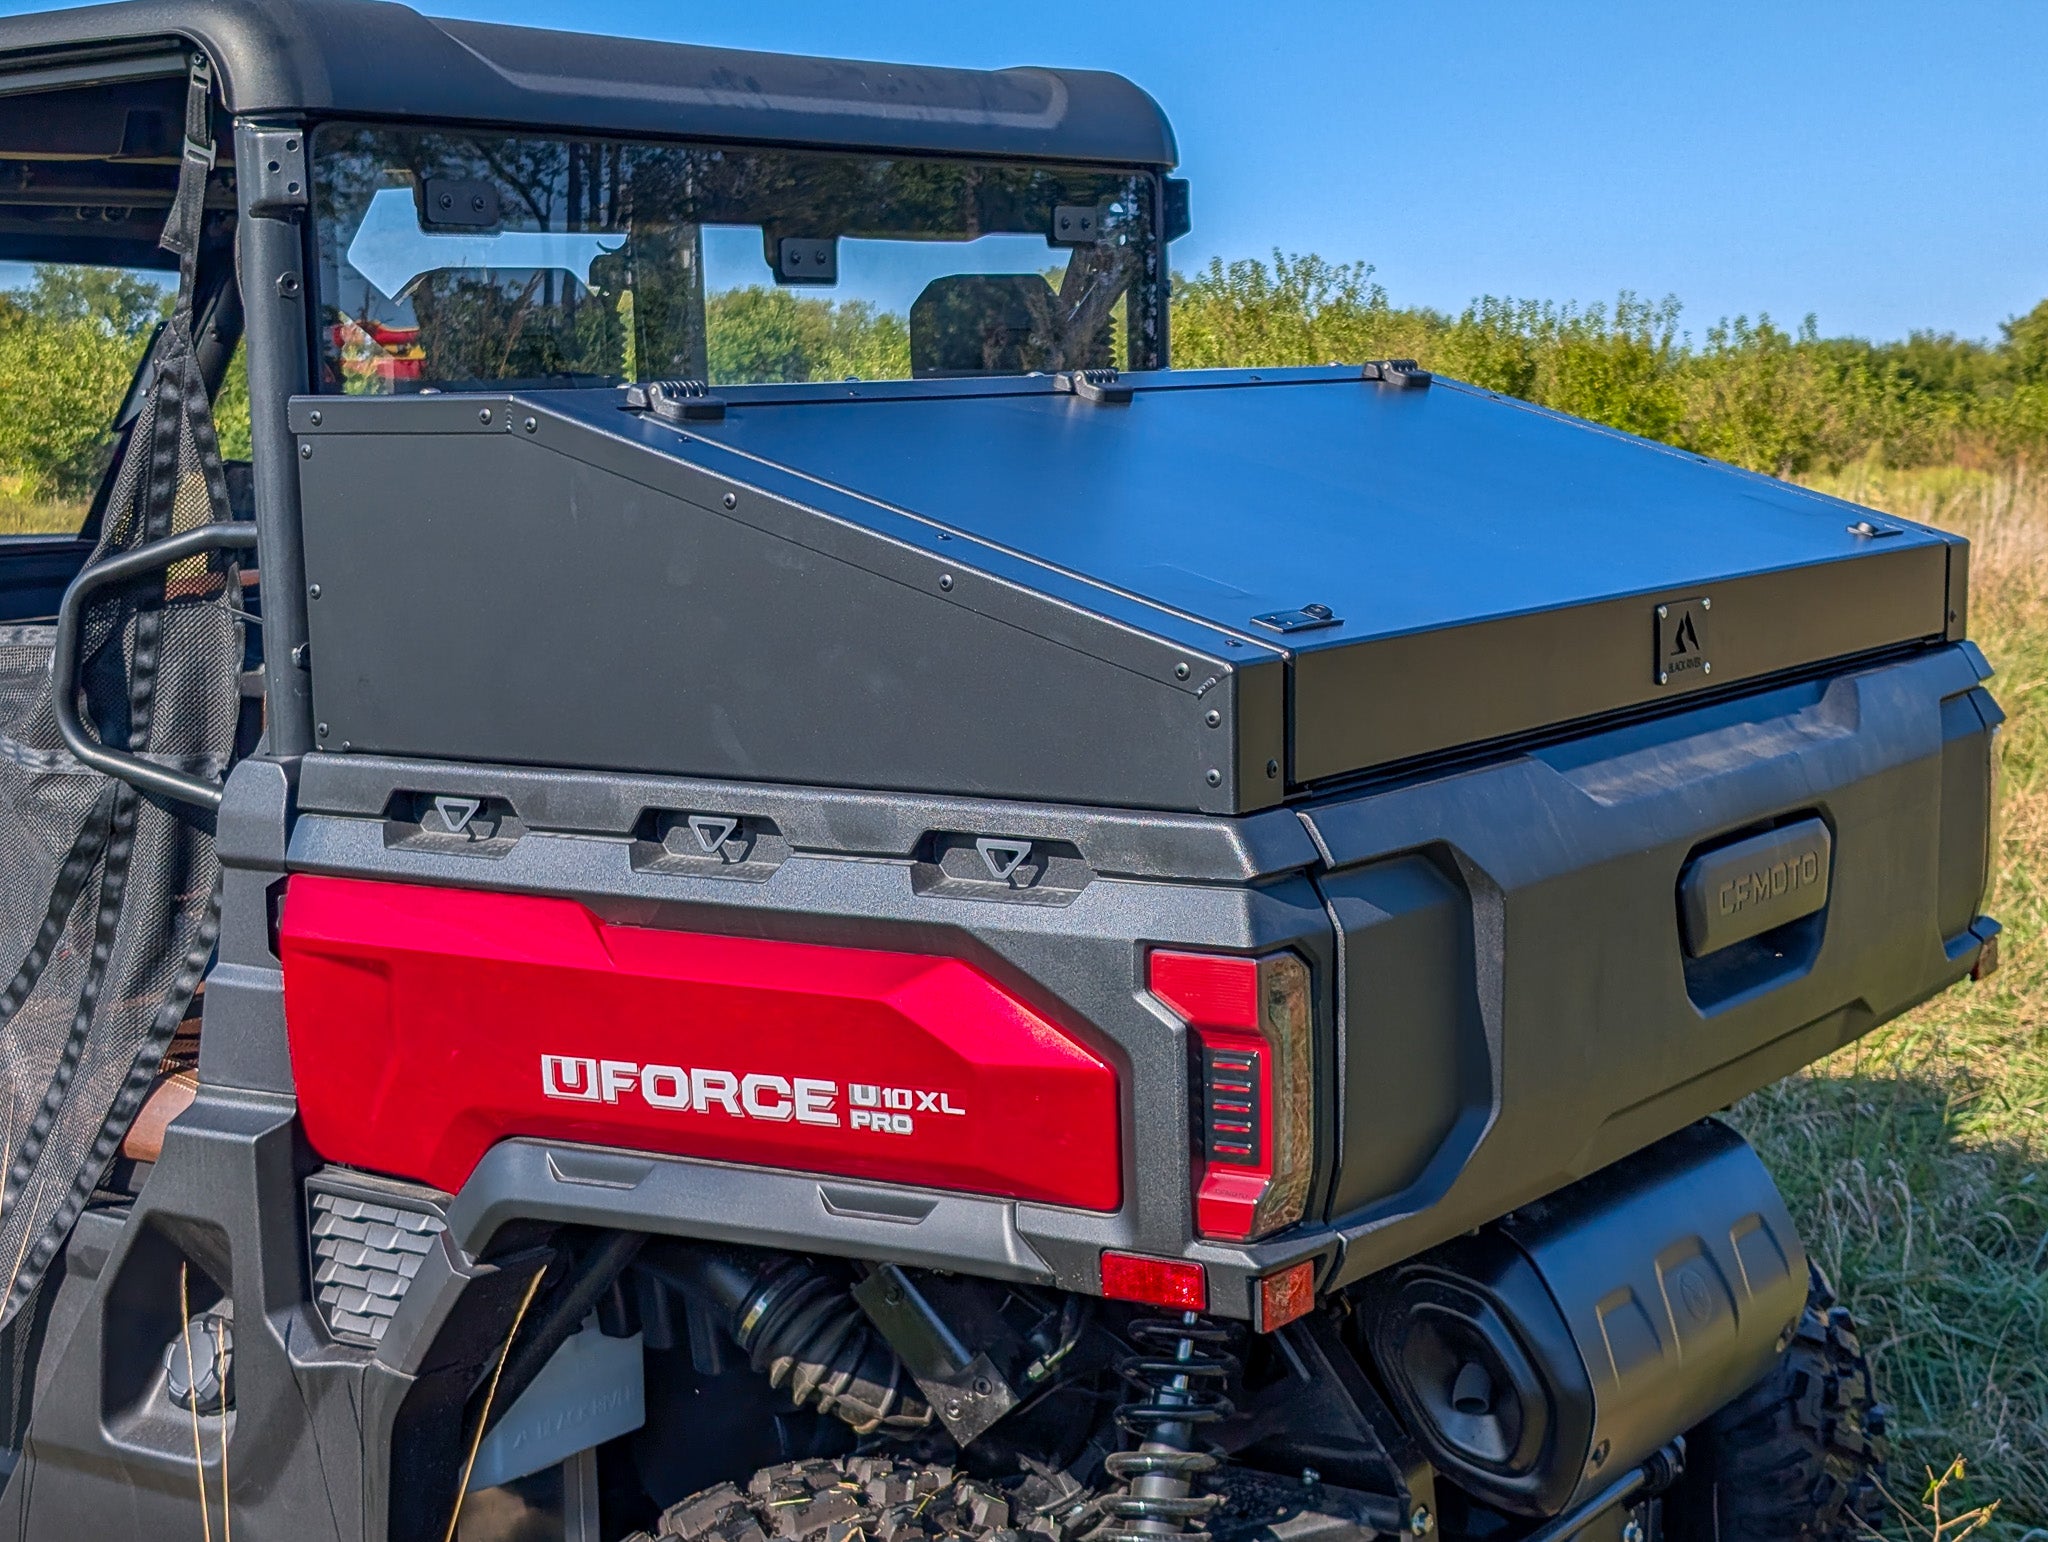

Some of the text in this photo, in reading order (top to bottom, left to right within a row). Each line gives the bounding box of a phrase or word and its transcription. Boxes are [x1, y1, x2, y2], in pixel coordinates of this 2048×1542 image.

[1720, 851, 1819, 916] CFMOTO
[541, 1053, 841, 1128] UFORCE
[850, 1109, 914, 1136] PRO
